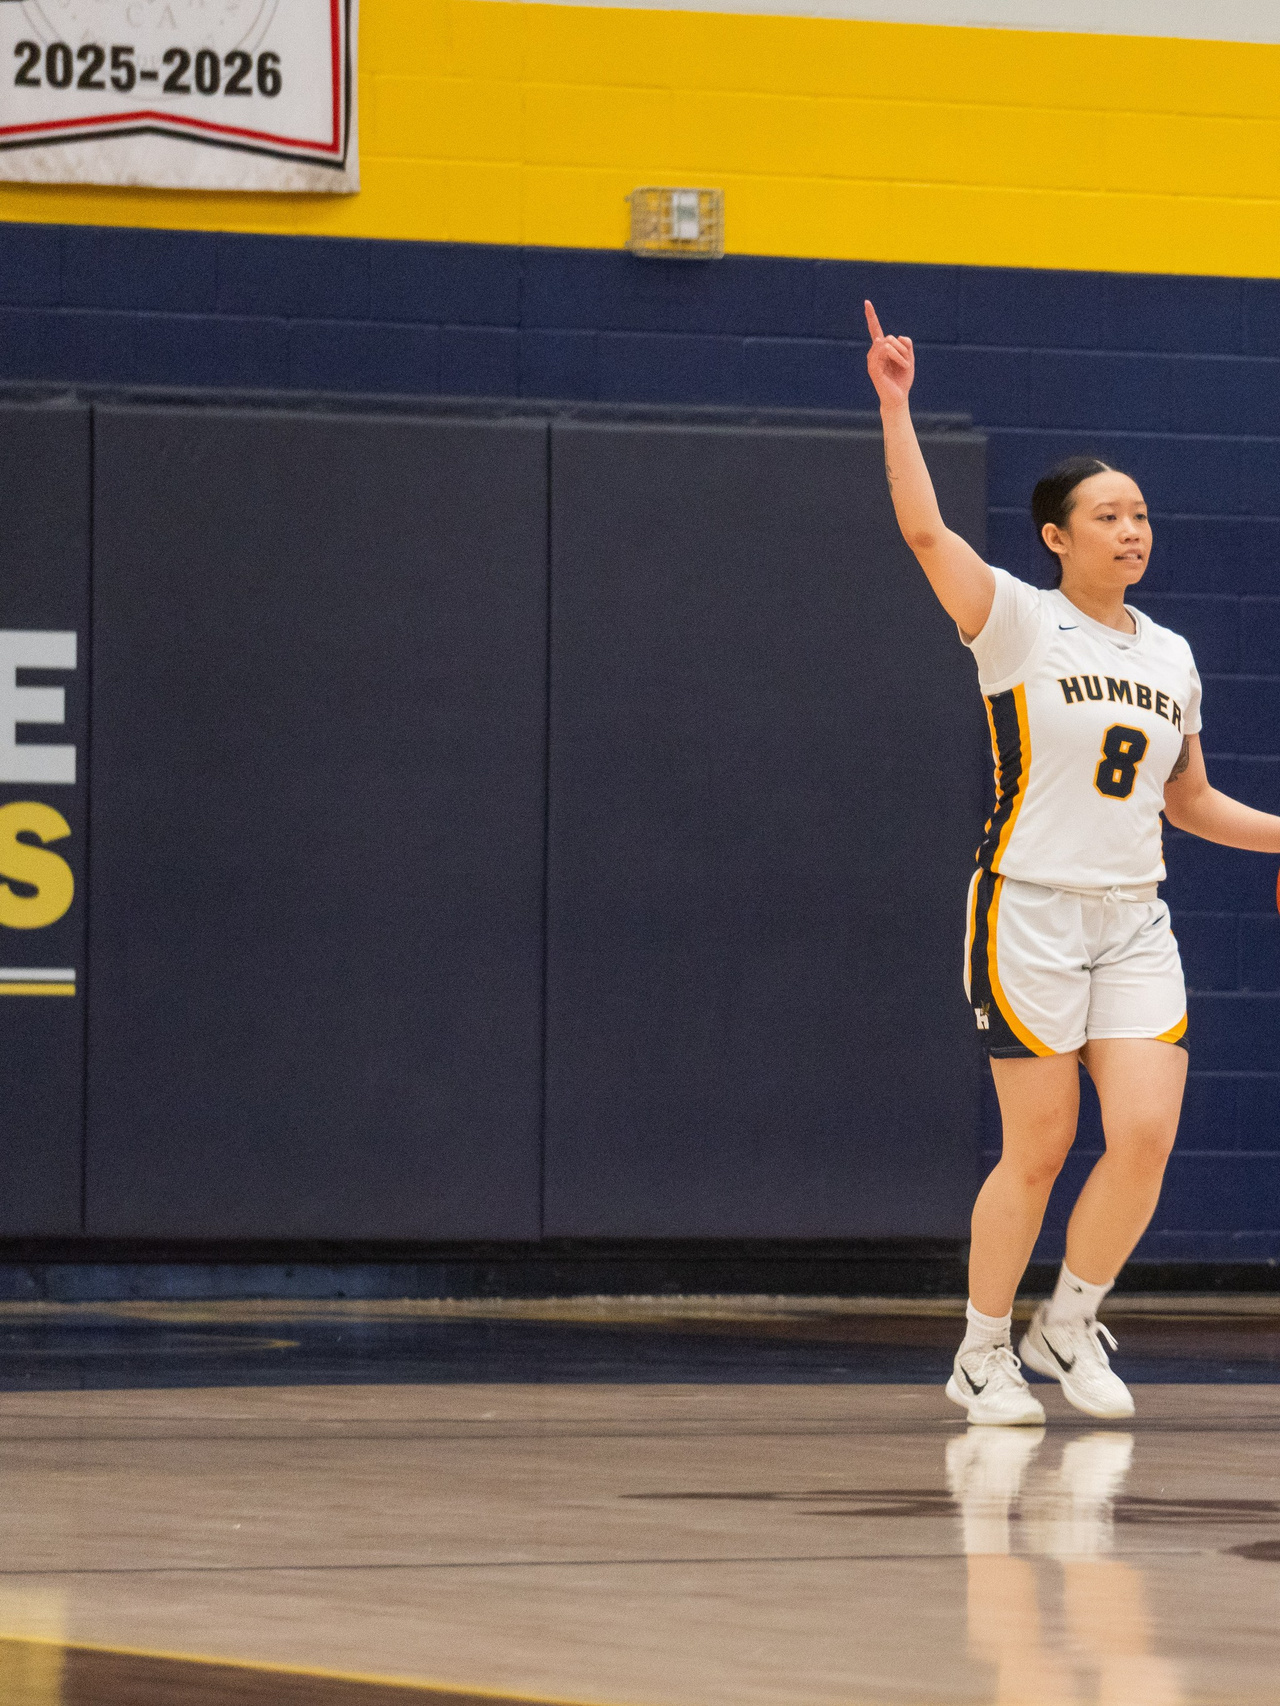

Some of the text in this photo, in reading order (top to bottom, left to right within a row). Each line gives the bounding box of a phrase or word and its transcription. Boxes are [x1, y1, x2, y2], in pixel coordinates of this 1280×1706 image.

[14, 40, 283, 99] 2025-2026
[1057, 674, 1182, 734] HUMBER
[1092, 722, 1150, 801] 8
